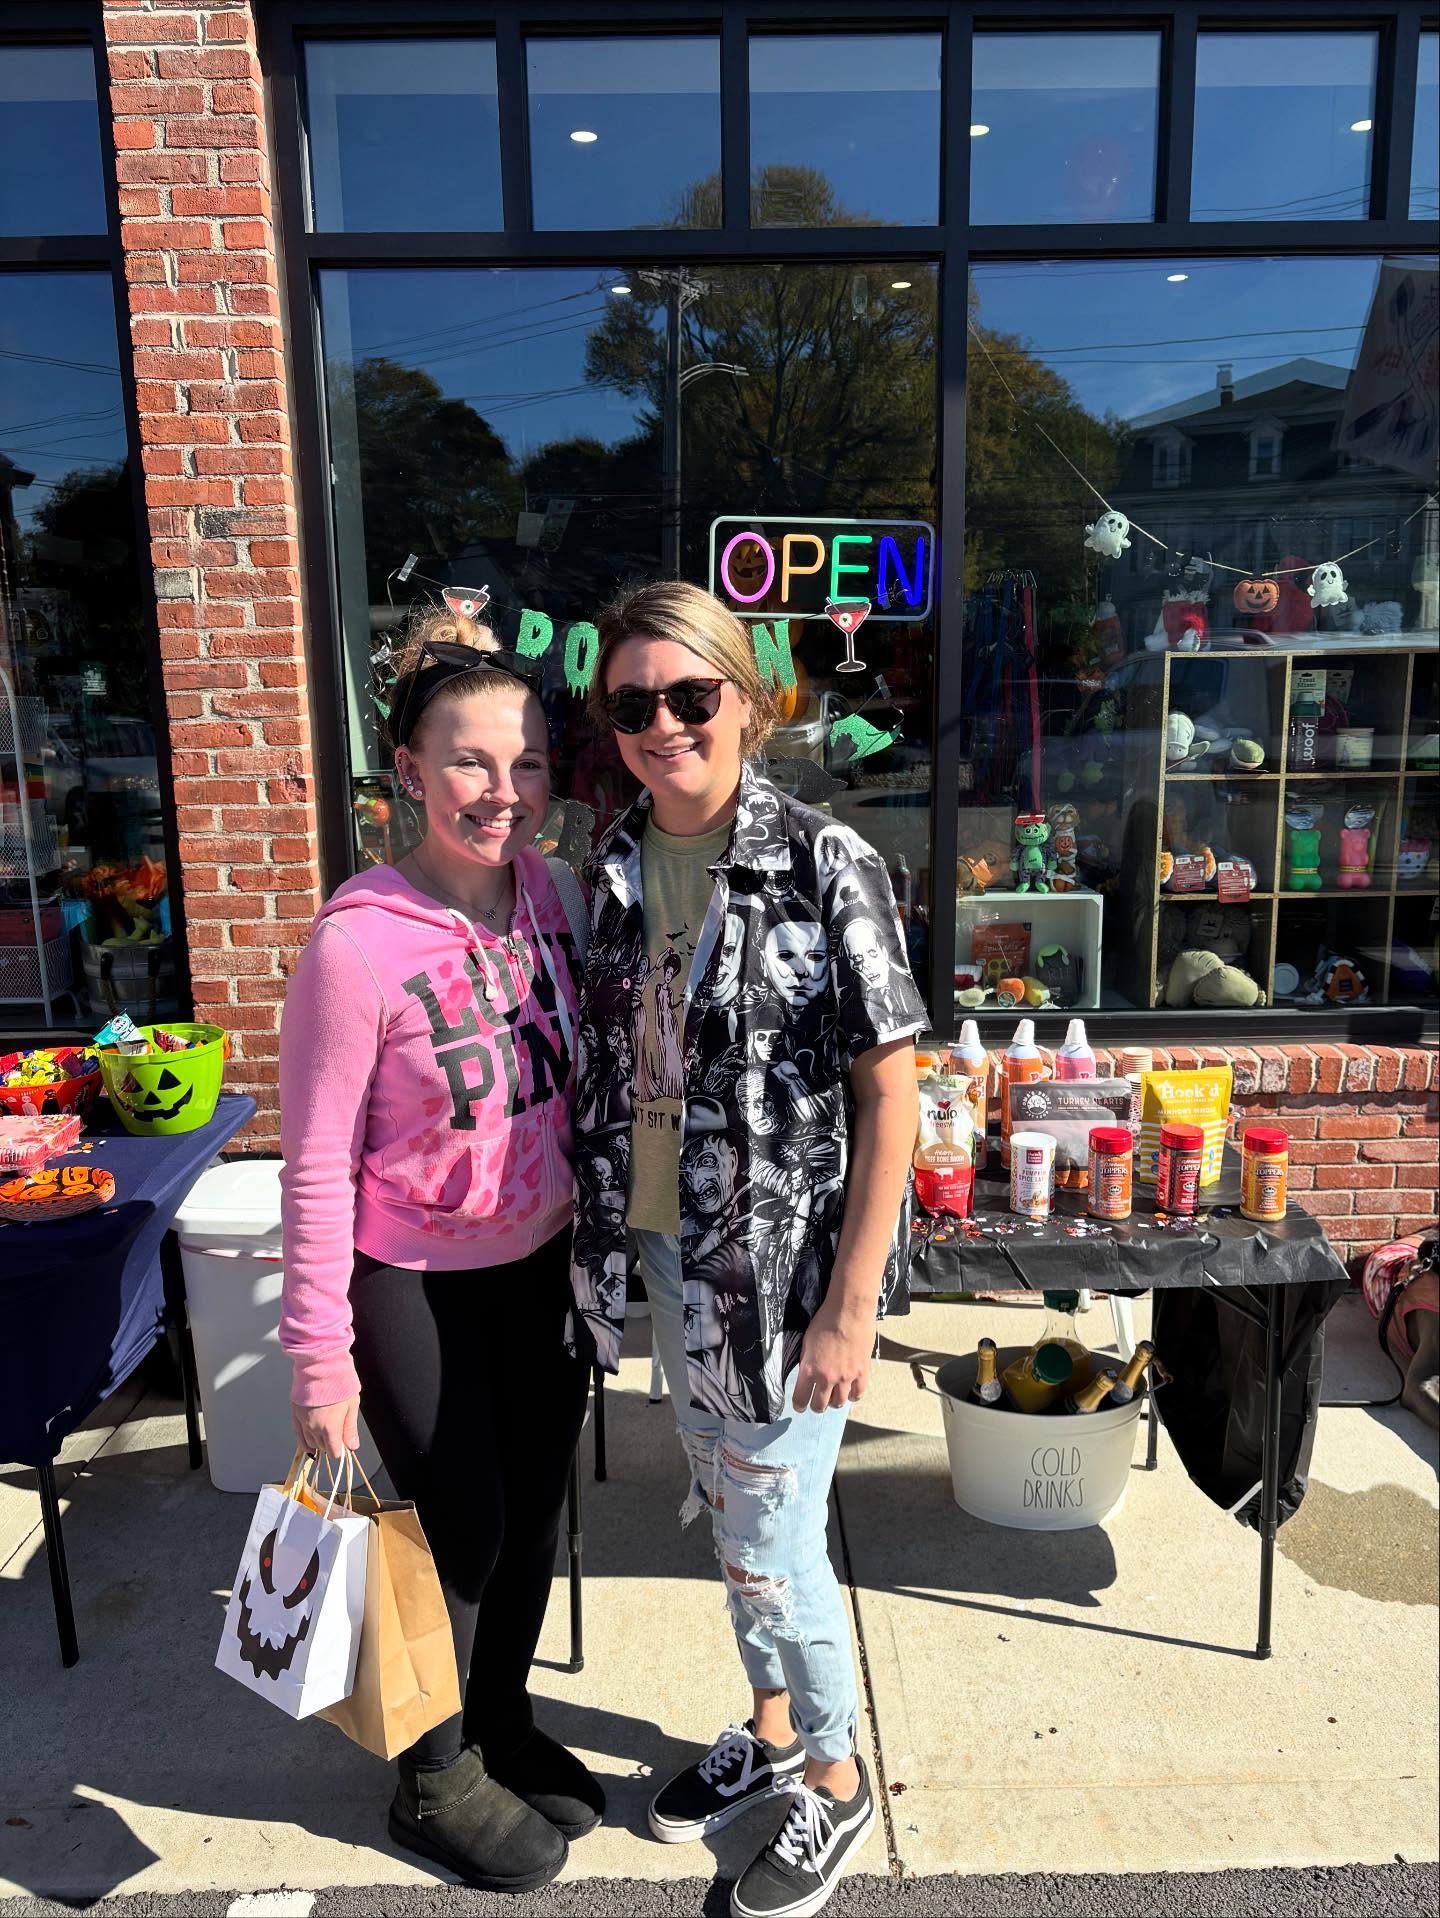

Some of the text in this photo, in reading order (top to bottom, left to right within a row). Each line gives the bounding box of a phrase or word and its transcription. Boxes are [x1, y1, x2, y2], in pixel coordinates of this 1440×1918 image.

[721, 531, 925, 607] OPEN
[1302, 723, 1316, 761] woof
[1157, 1081, 1219, 1099] Hook'd
[1057, 1097, 1124, 1105] TURKEY HEARTS
[648, 1110, 665, 1130] SIT
[927, 1106, 958, 1121] nulo
[1100, 1167, 1127, 1175] TOPPERS
[1176, 1164, 1200, 1172] TOPPER
[1256, 1168, 1284, 1176] TOPPERS
[1031, 1446, 1082, 1477] COLD
[1024, 1477, 1086, 1509] DRINKS
